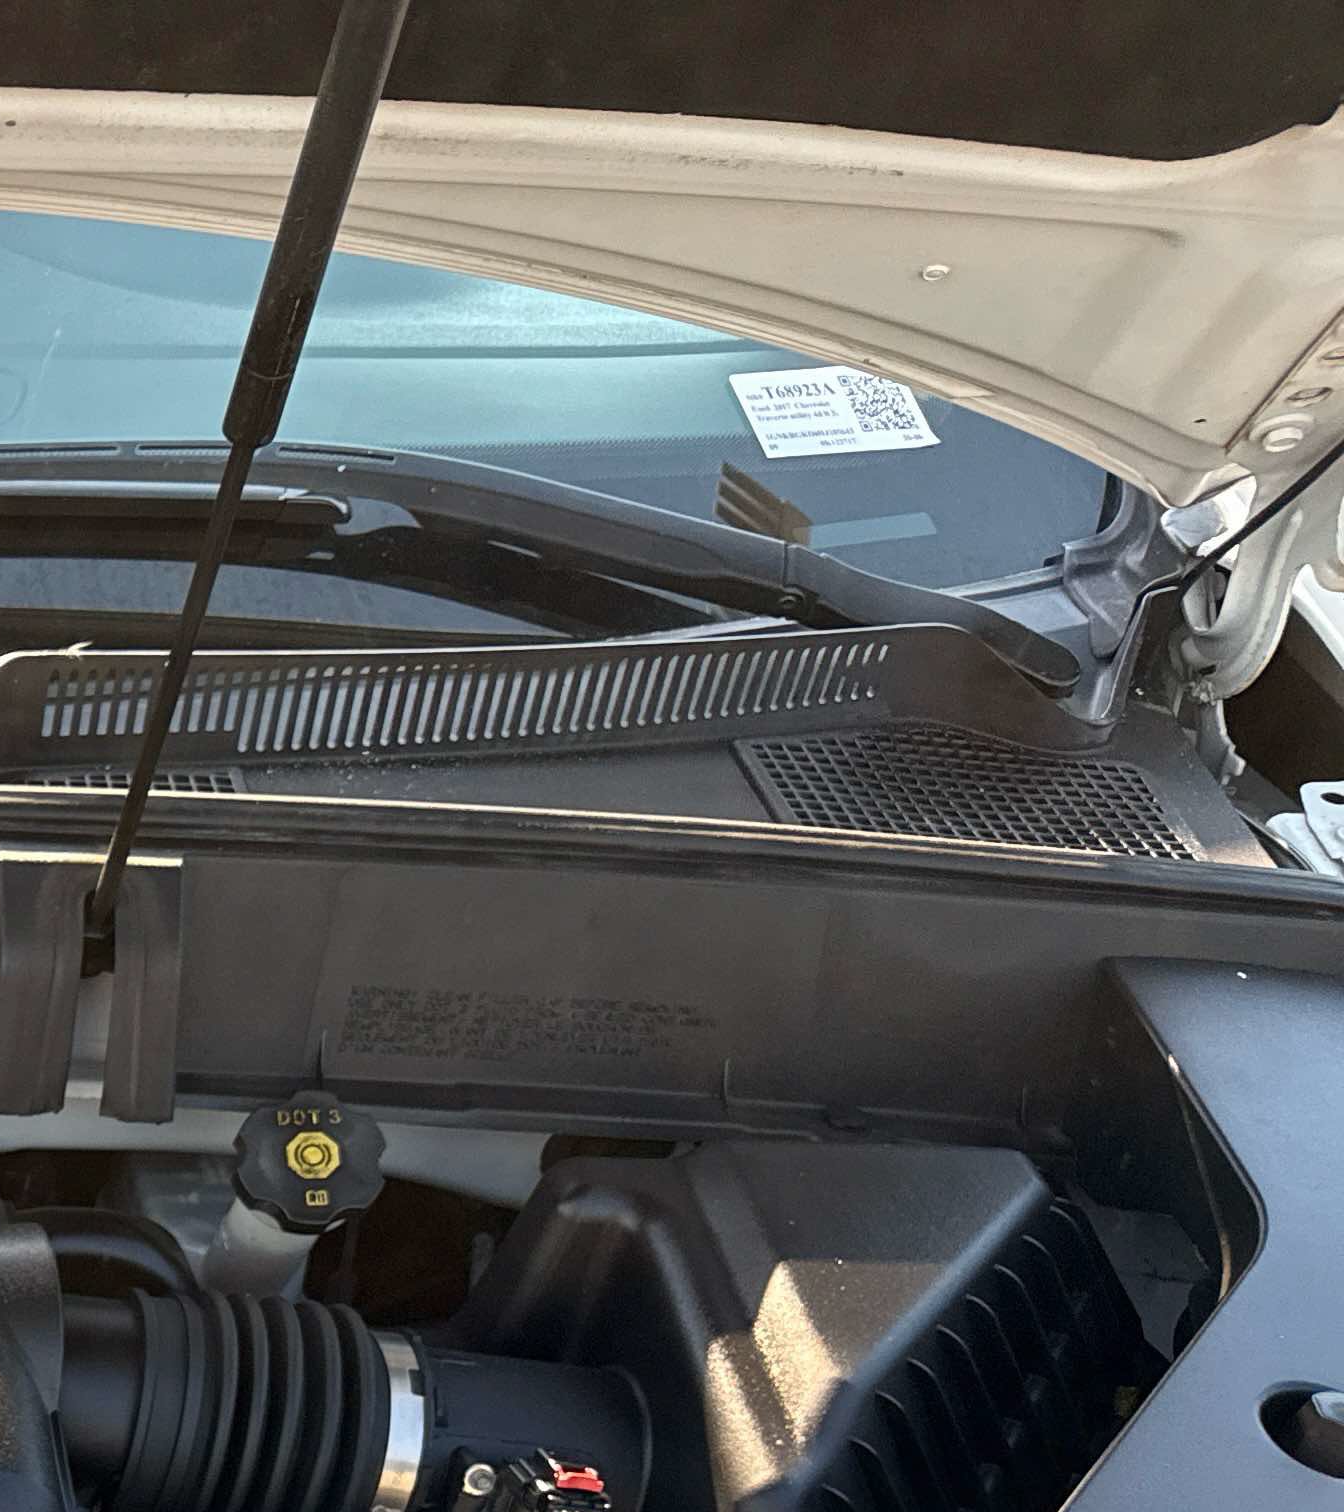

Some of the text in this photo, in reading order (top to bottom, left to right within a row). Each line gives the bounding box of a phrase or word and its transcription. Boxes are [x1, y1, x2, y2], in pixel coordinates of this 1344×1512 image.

[760, 383, 836, 399] T68923A
[277, 1108, 342, 1126] DOT 3
